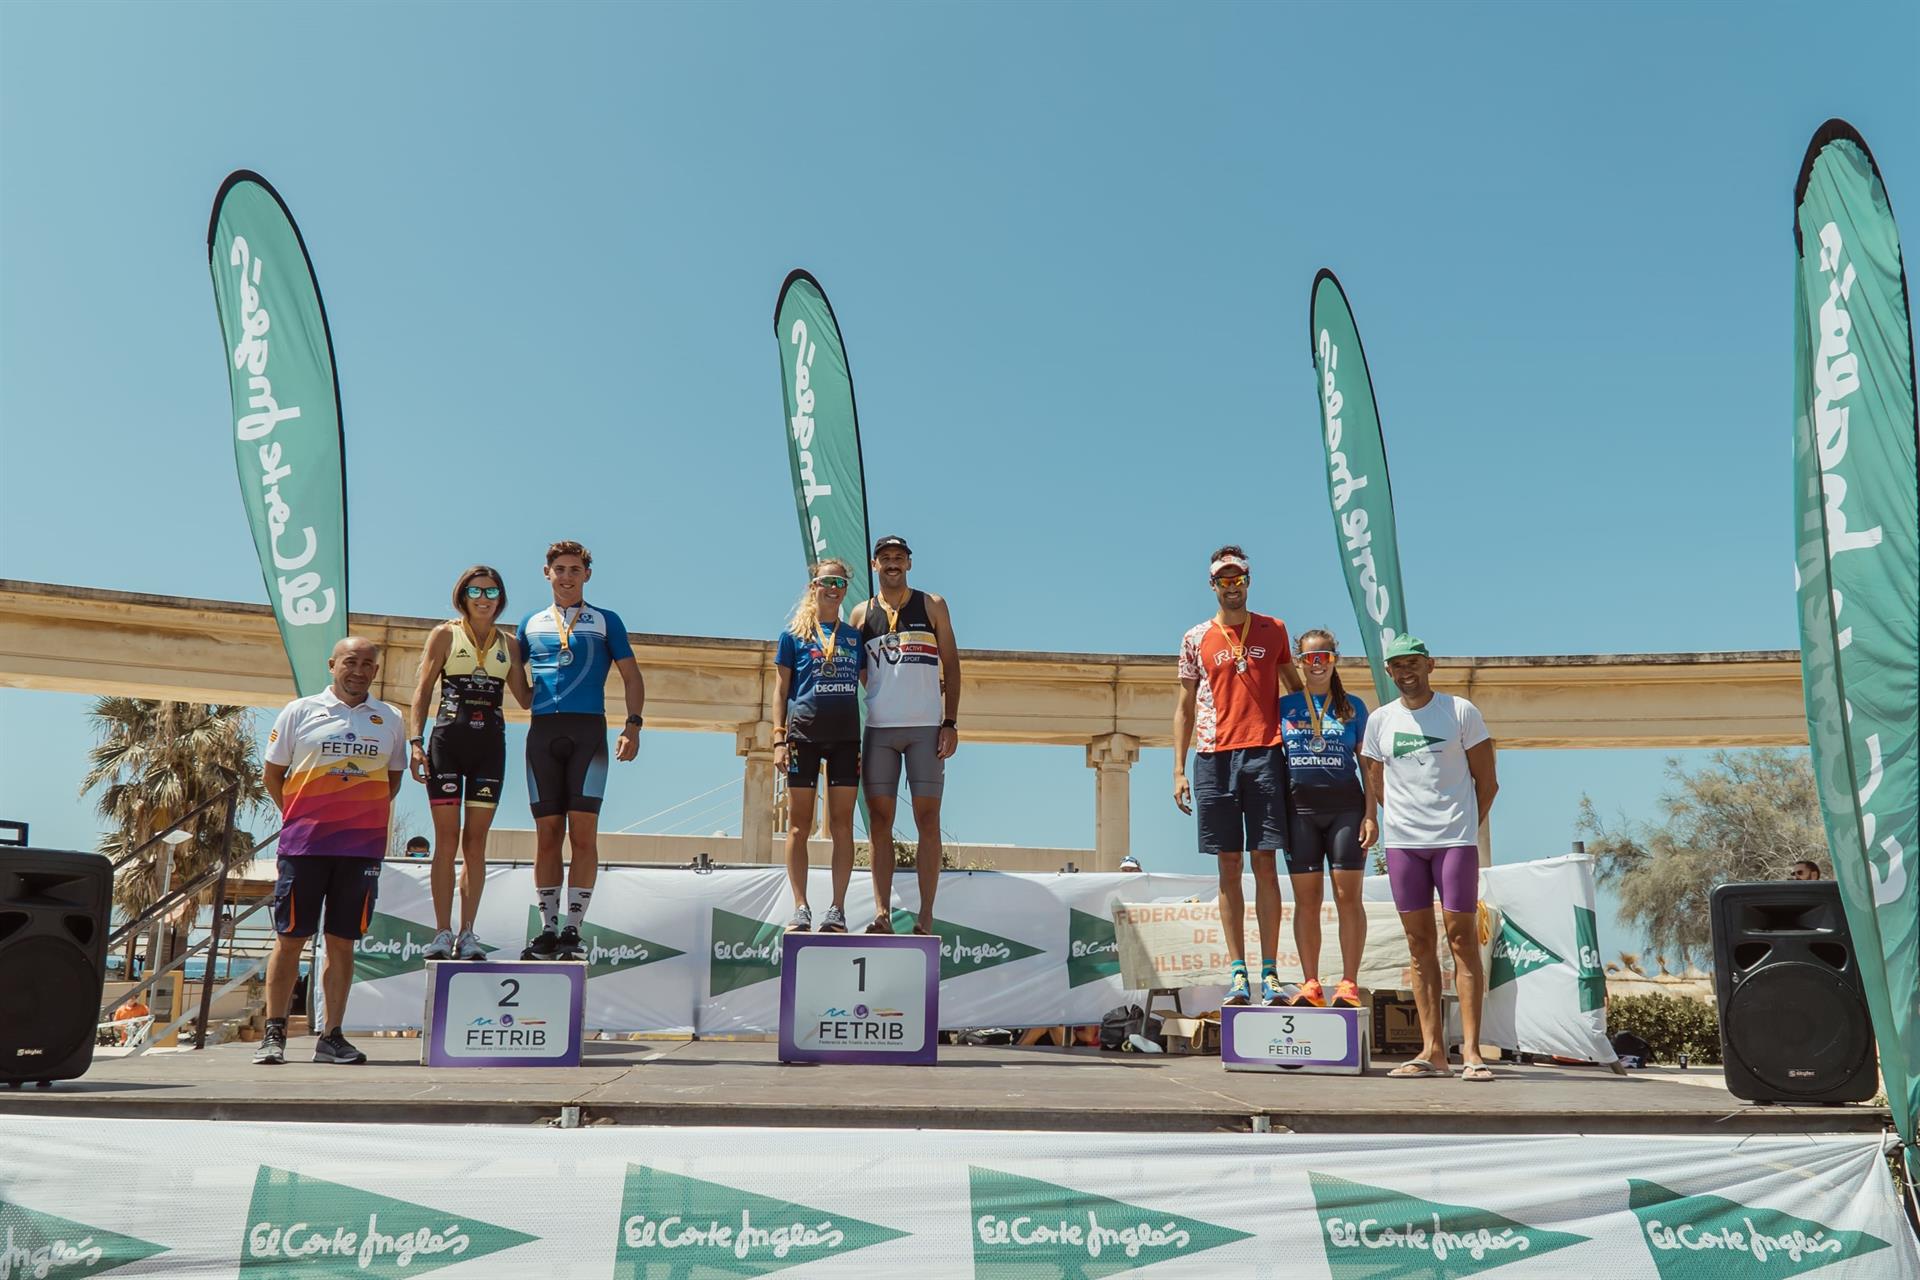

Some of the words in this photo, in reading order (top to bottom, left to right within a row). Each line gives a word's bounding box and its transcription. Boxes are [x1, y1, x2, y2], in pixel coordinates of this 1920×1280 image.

[321, 741, 379, 756] FETRIB
[1290, 756, 1342, 767] DECATHLON
[361, 935, 402, 954] Corte
[1193, 928, 1219, 944] DE
[590, 936, 649, 965] Inglés
[714, 940, 732, 960] El
[732, 941, 771, 960] Corte
[952, 935, 1011, 965] Inglés
[1072, 940, 1087, 957] El
[1154, 953, 1204, 972] ILLES
[852, 956, 866, 992] 1
[497, 978, 520, 1008] 2
[819, 1021, 904, 1040] FETRIB
[1281, 1015, 1296, 1034] 3
[466, 1029, 546, 1046] FETRIB
[1268, 1045, 1312, 1056] FETRIB
[249, 1222, 282, 1258] El
[281, 1222, 357, 1259] Corte
[357, 1213, 470, 1269] Inglés
[624, 1214, 656, 1249] El
[656, 1215, 733, 1250] Corte
[734, 1209, 845, 1260] Inglés
[977, 1215, 1011, 1247] El
[1010, 1216, 1084, 1248] Corte
[1086, 1210, 1190, 1257] Inglés
[1325, 1216, 1359, 1249] El
[1359, 1217, 1430, 1251] Corte
[1431, 1212, 1531, 1261] Inglés
[1647, 1219, 1681, 1252] El
[1680, 1221, 1746, 1255] Corte
[1744, 1216, 1844, 1264] Inglés
